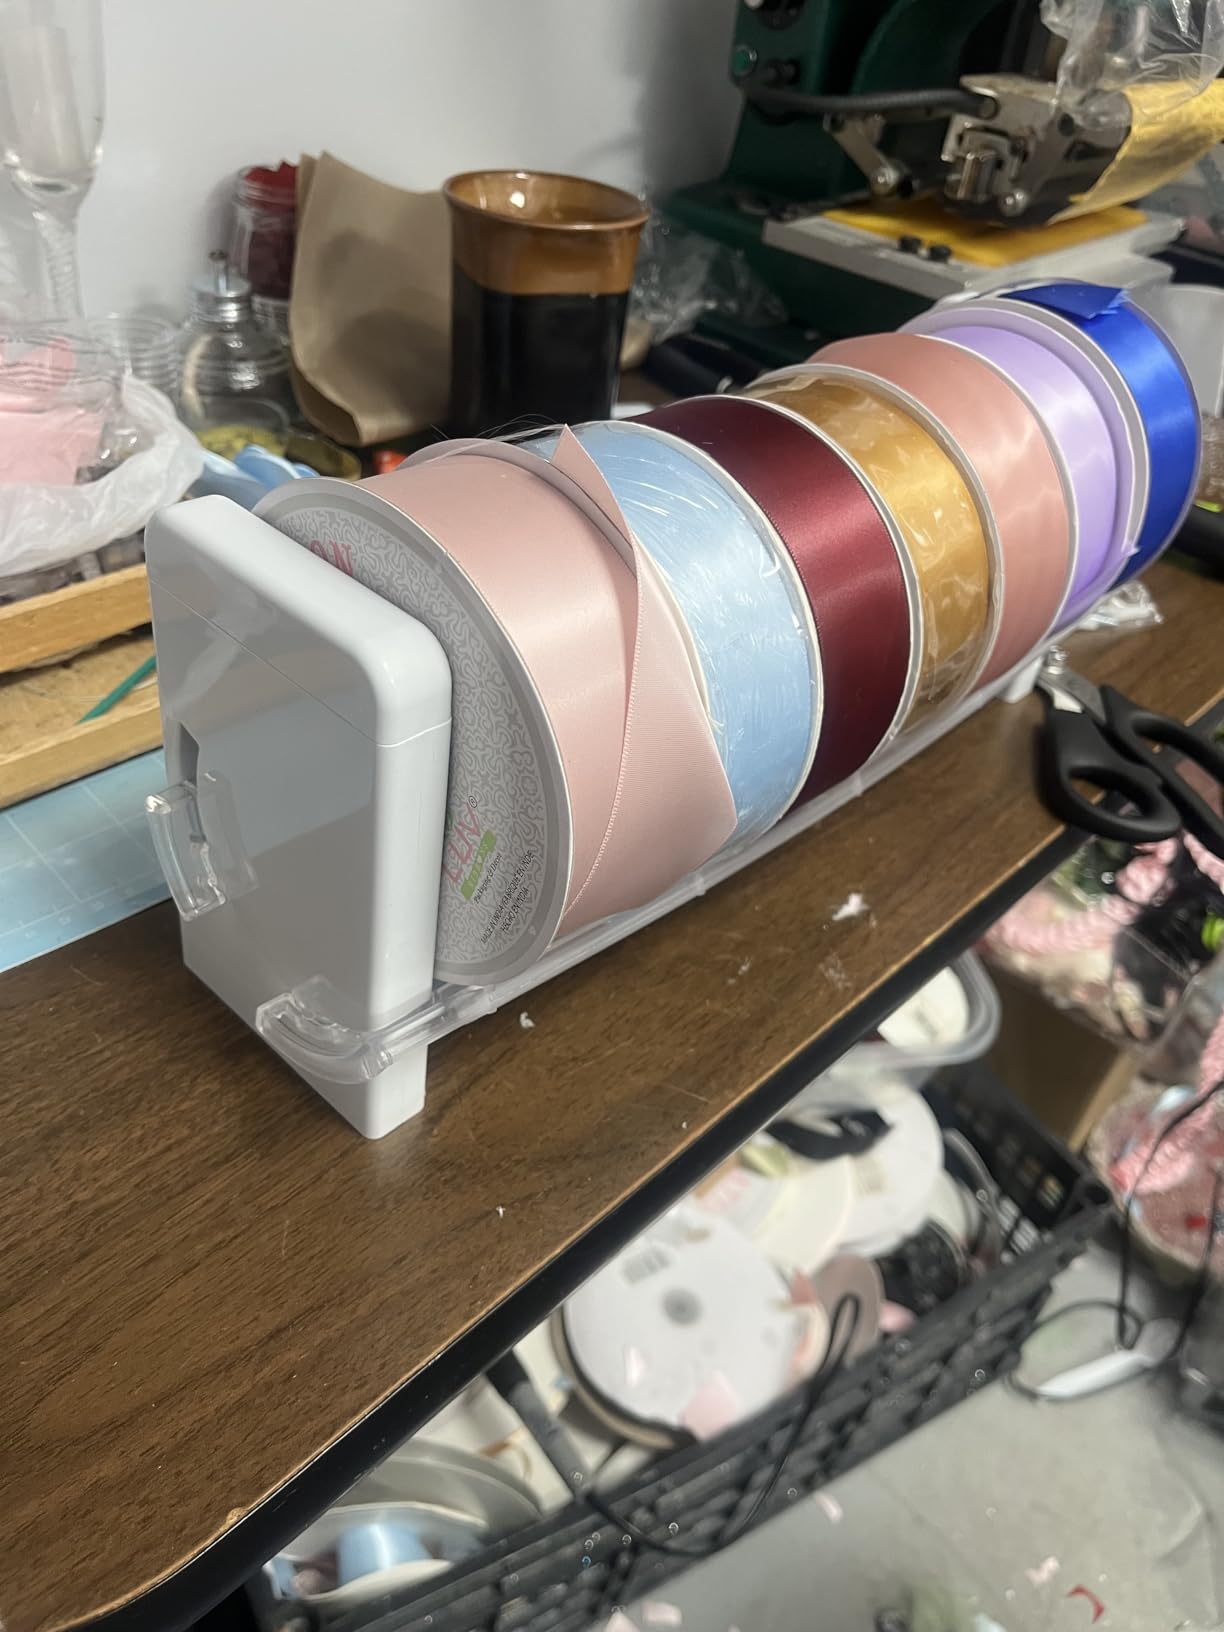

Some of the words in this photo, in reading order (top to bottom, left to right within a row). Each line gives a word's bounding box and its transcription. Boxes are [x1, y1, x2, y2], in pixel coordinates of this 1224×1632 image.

[480, 927, 493, 944] MADE
[493, 905, 505, 923] INDIA
[521, 850, 534, 869] INDE
[501, 911, 515, 933] HECHO
[516, 886, 529, 905] INDIA
